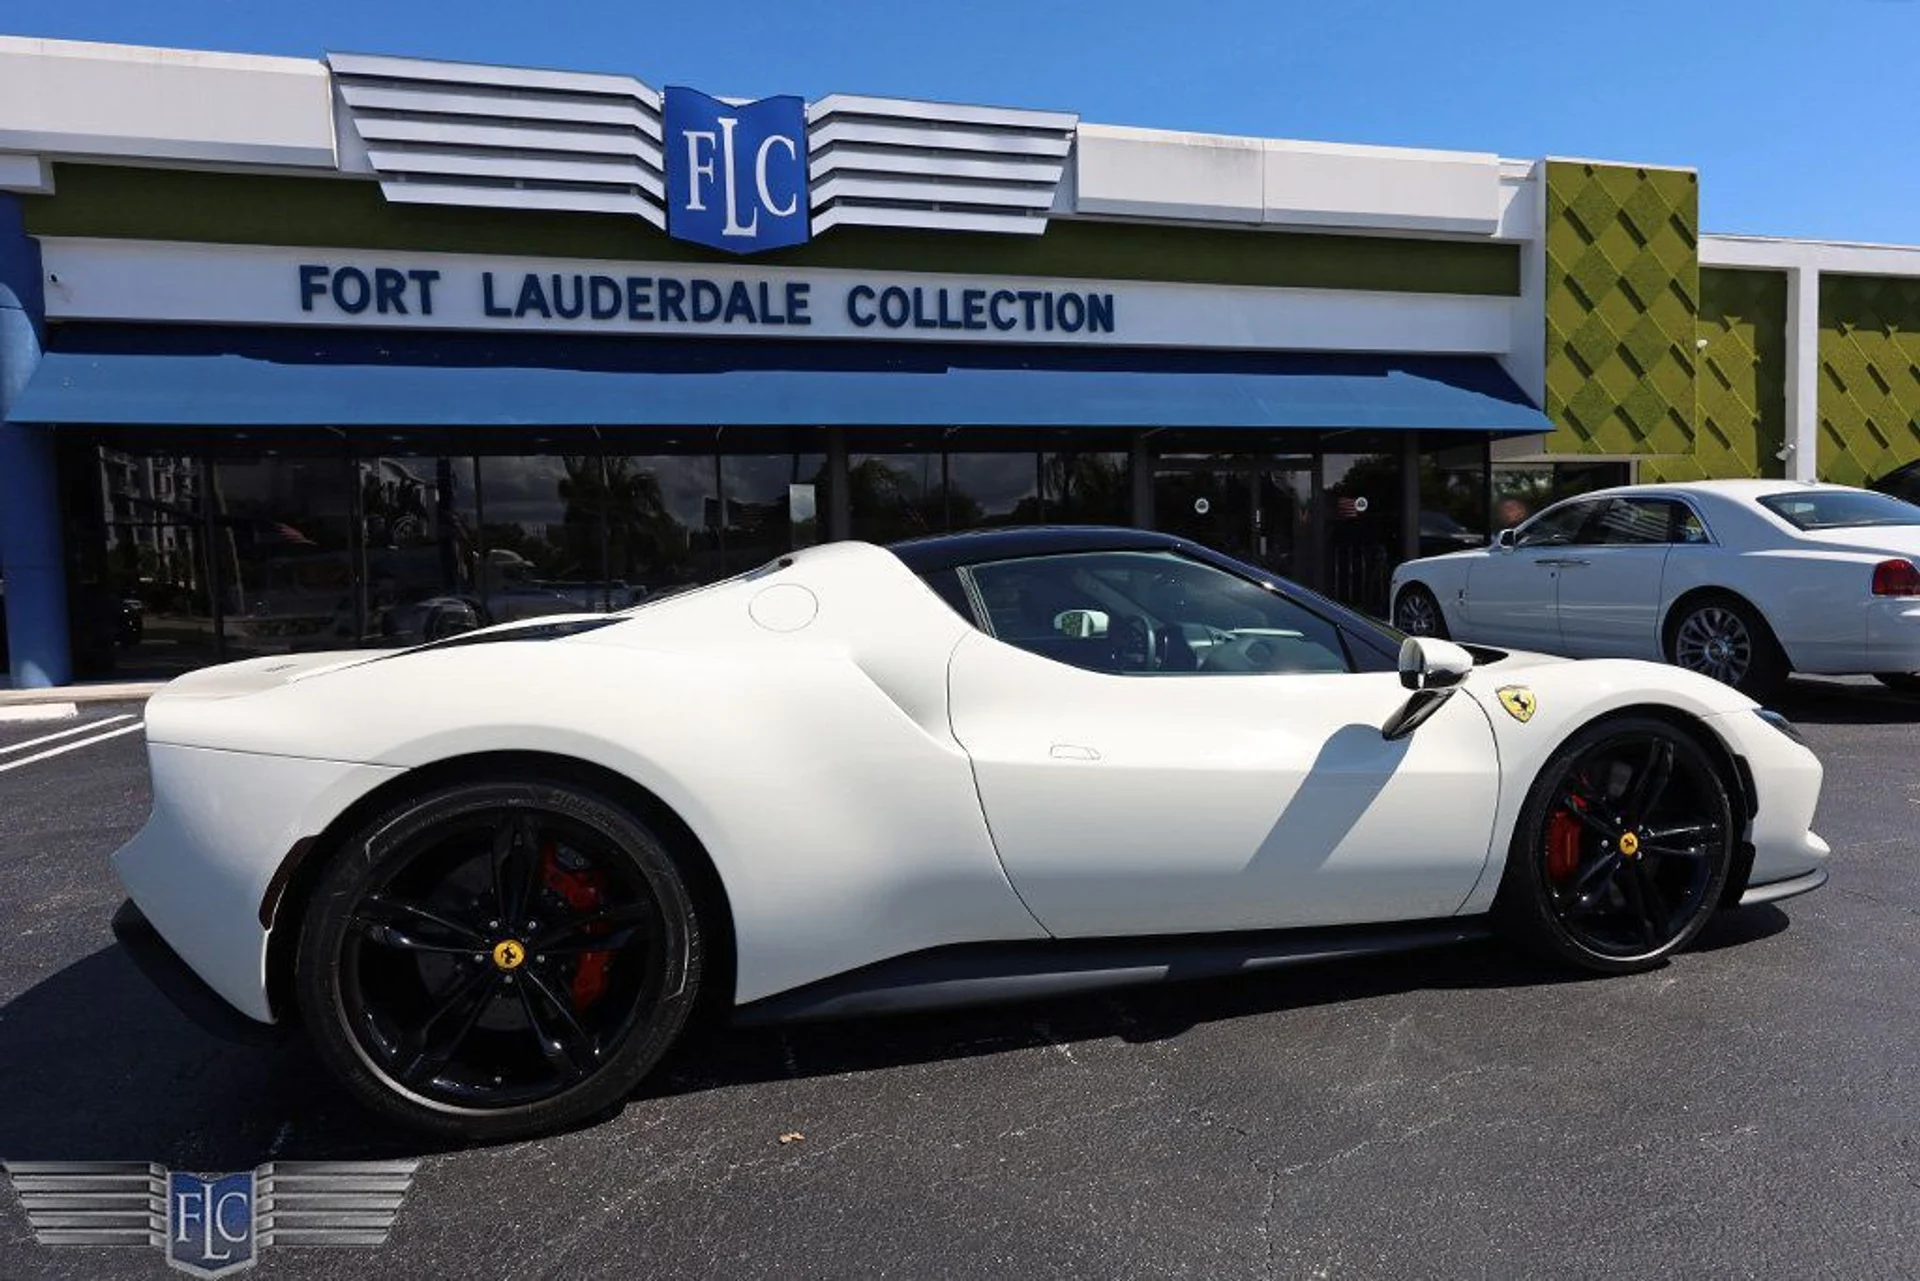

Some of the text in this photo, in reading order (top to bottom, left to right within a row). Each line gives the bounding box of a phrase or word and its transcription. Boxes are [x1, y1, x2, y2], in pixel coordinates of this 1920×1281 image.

[682, 117, 797, 238] FLC
[299, 264, 1114, 333] FORT LAUDERDALE COLLECTION
